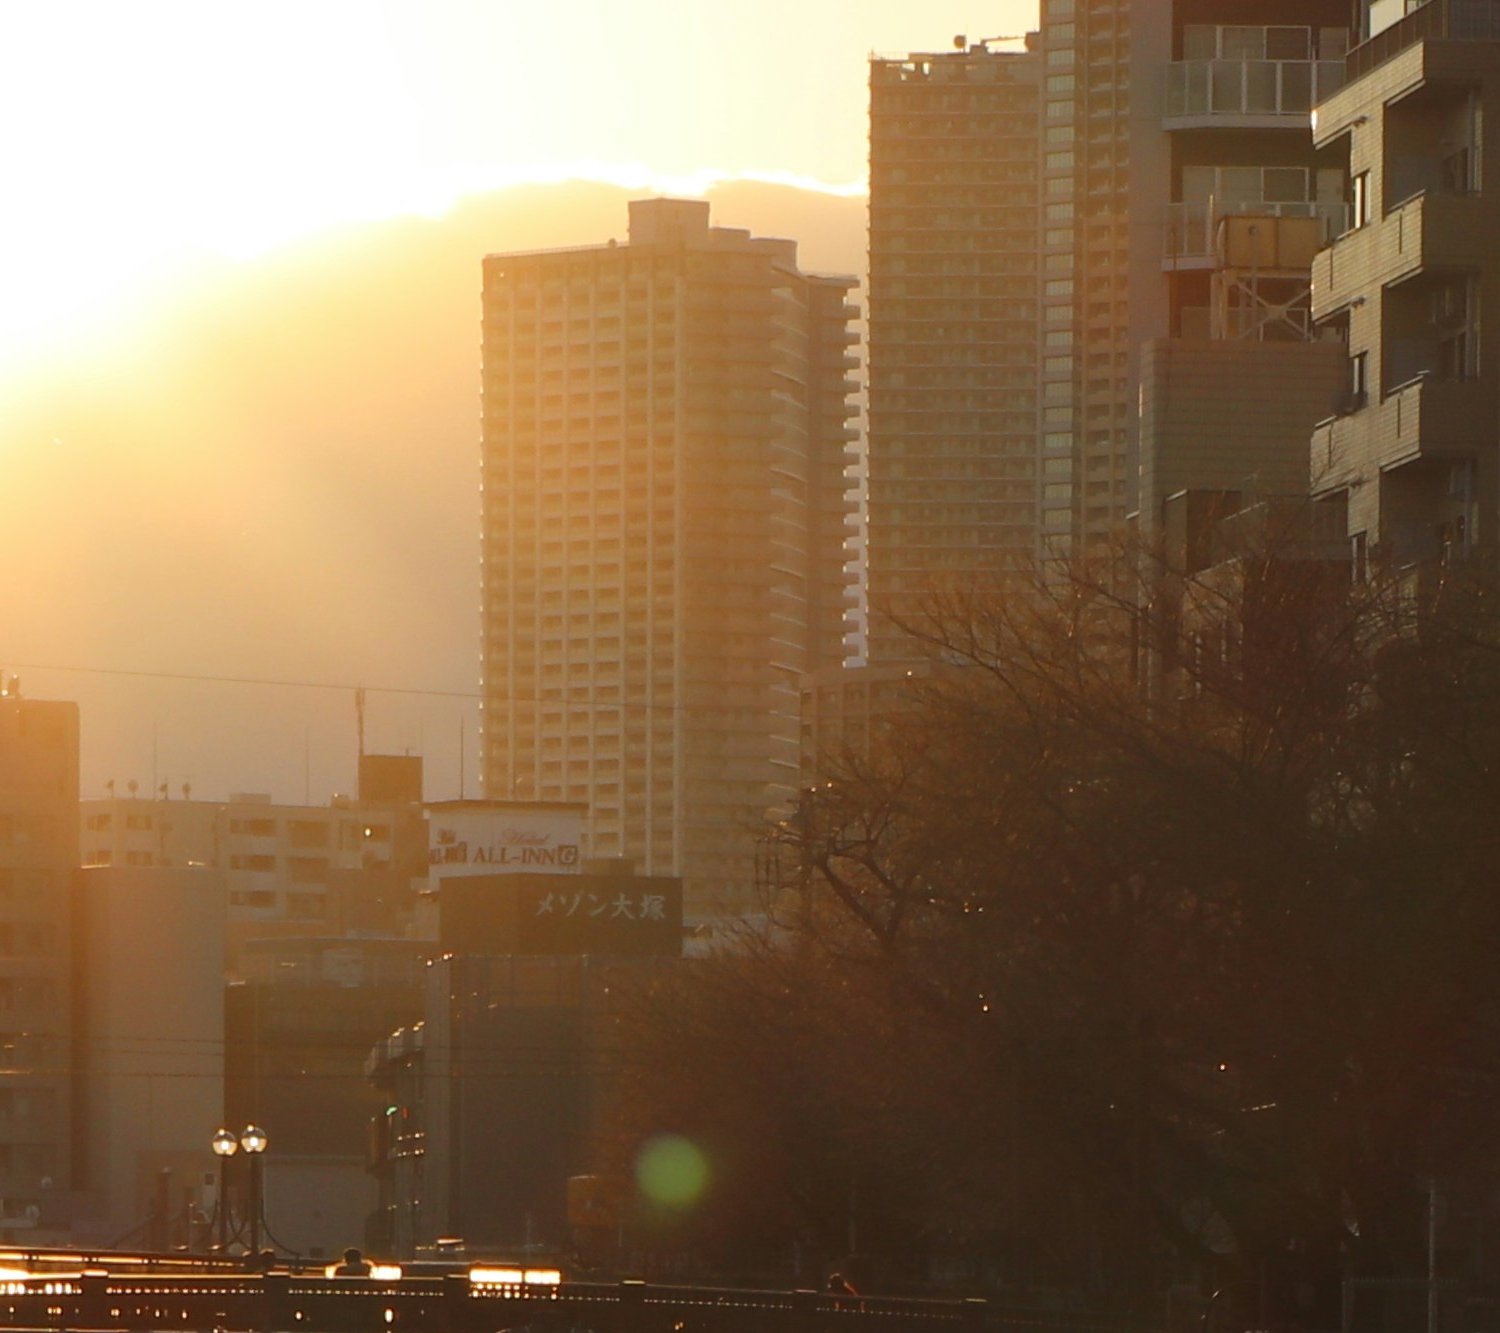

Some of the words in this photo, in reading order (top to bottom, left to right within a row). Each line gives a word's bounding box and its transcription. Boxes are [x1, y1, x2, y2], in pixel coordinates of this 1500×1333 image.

[535, 891, 667, 920] メゾン大塚
